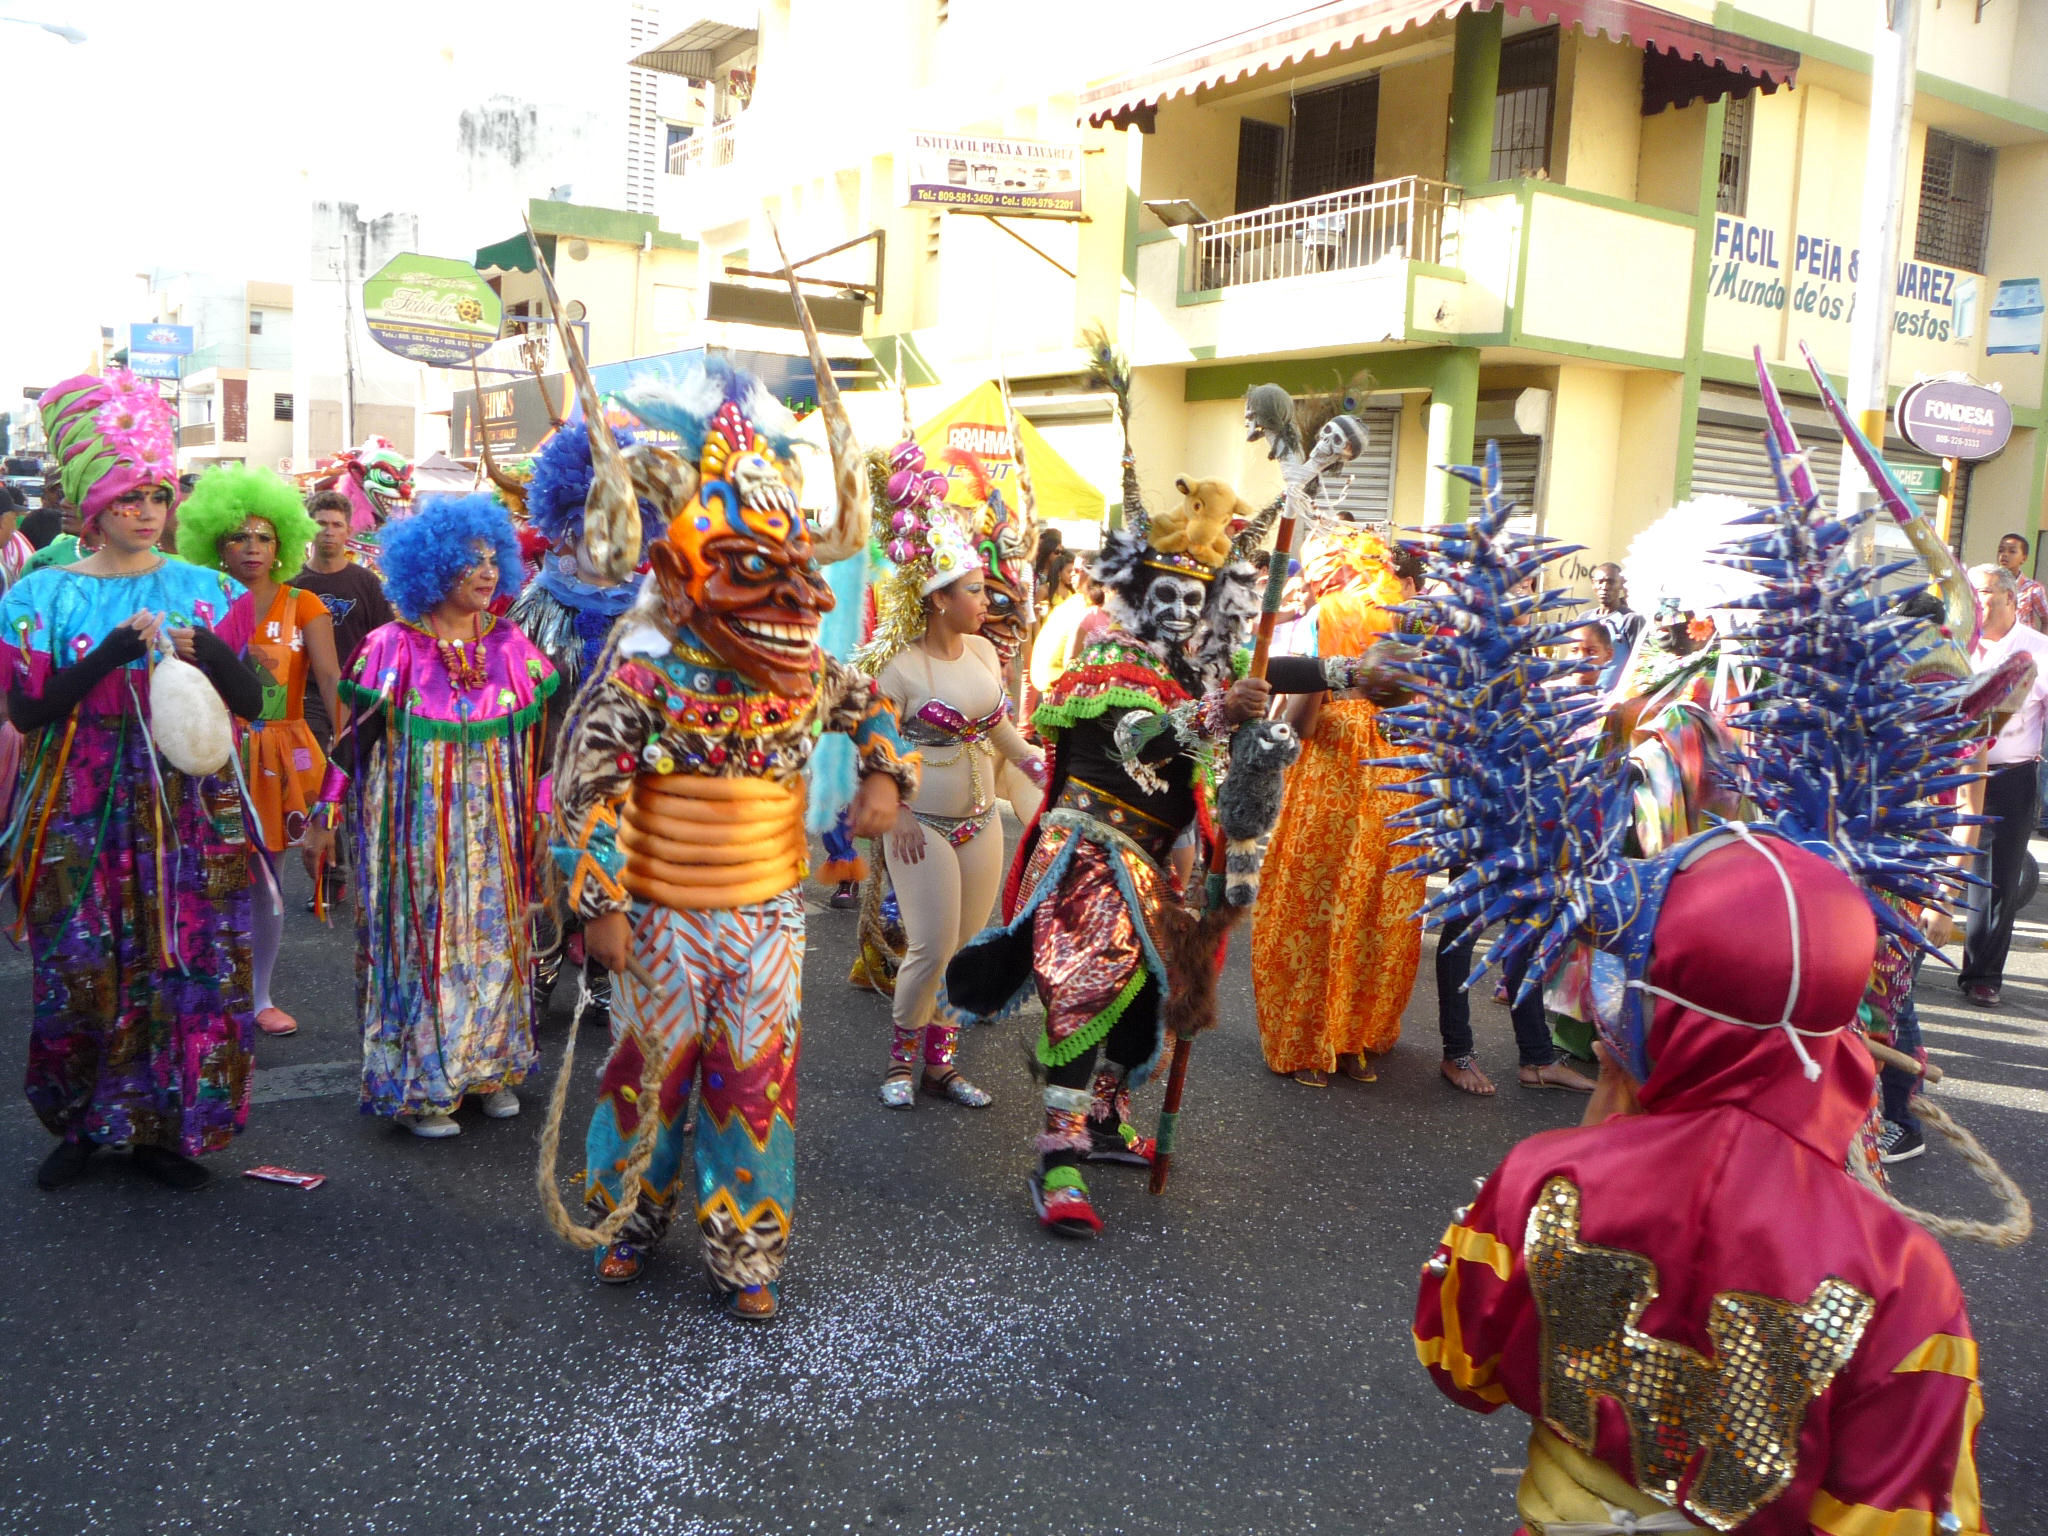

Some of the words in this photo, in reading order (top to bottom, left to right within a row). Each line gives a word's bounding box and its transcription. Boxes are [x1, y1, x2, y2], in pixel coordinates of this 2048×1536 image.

[918, 189, 937, 201] Tel.:
[938, 190, 994, 204] 809-581-3450
[1001, 195, 1020, 206] Cel.:
[1021, 196, 1074, 211] 809-979-2201
[1714, 218, 1779, 269] FACIL
[1896, 261, 1955, 307] VAREZ
[1714, 261, 1785, 310] Mundo
[383, 287, 456, 317] Fabiola
[1925, 399, 1995, 427] FONDESA
[948, 426, 1015, 455] BRAHMA
[947, 463, 1014, 480] LHT
